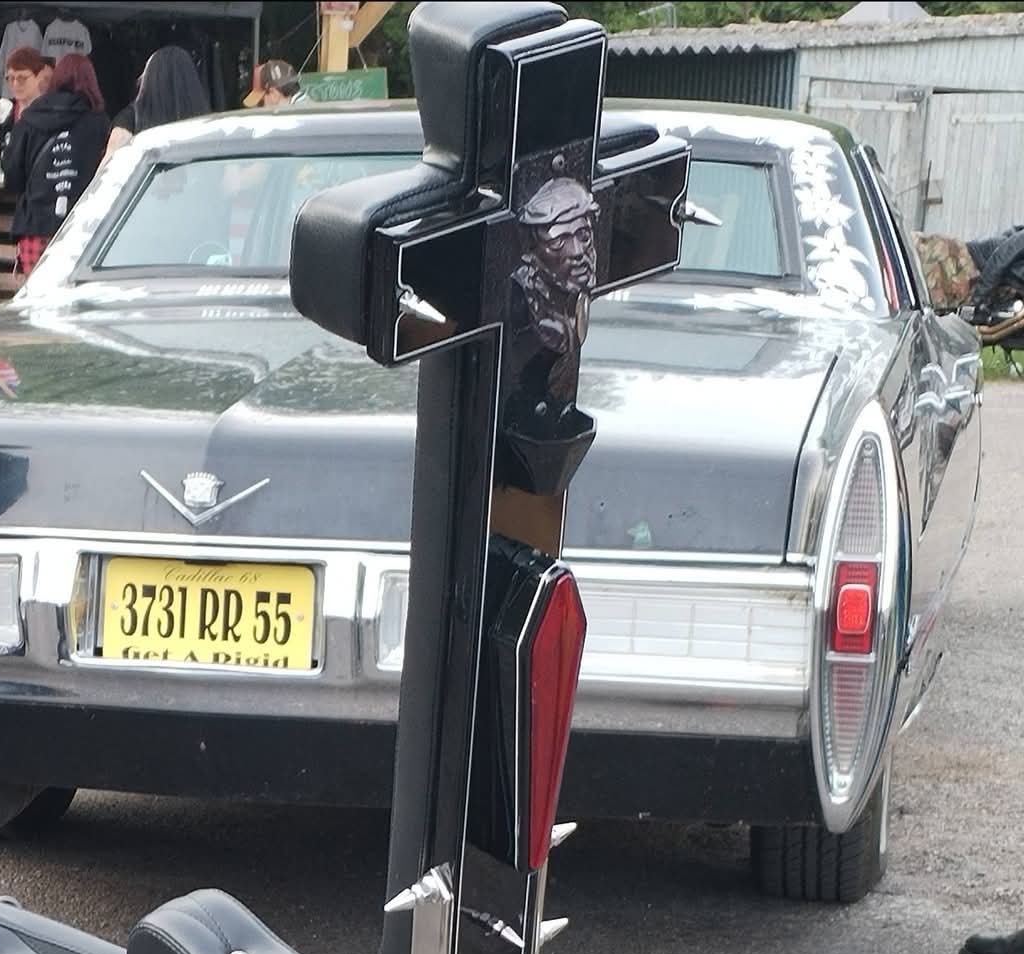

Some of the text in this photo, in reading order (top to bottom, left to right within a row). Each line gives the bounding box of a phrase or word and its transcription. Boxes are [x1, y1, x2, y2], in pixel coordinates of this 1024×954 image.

[163, 566, 260, 584] Cadillac 68
[120, 582, 292, 646] 3731 RR 55
[184, 650, 199, 663] A
